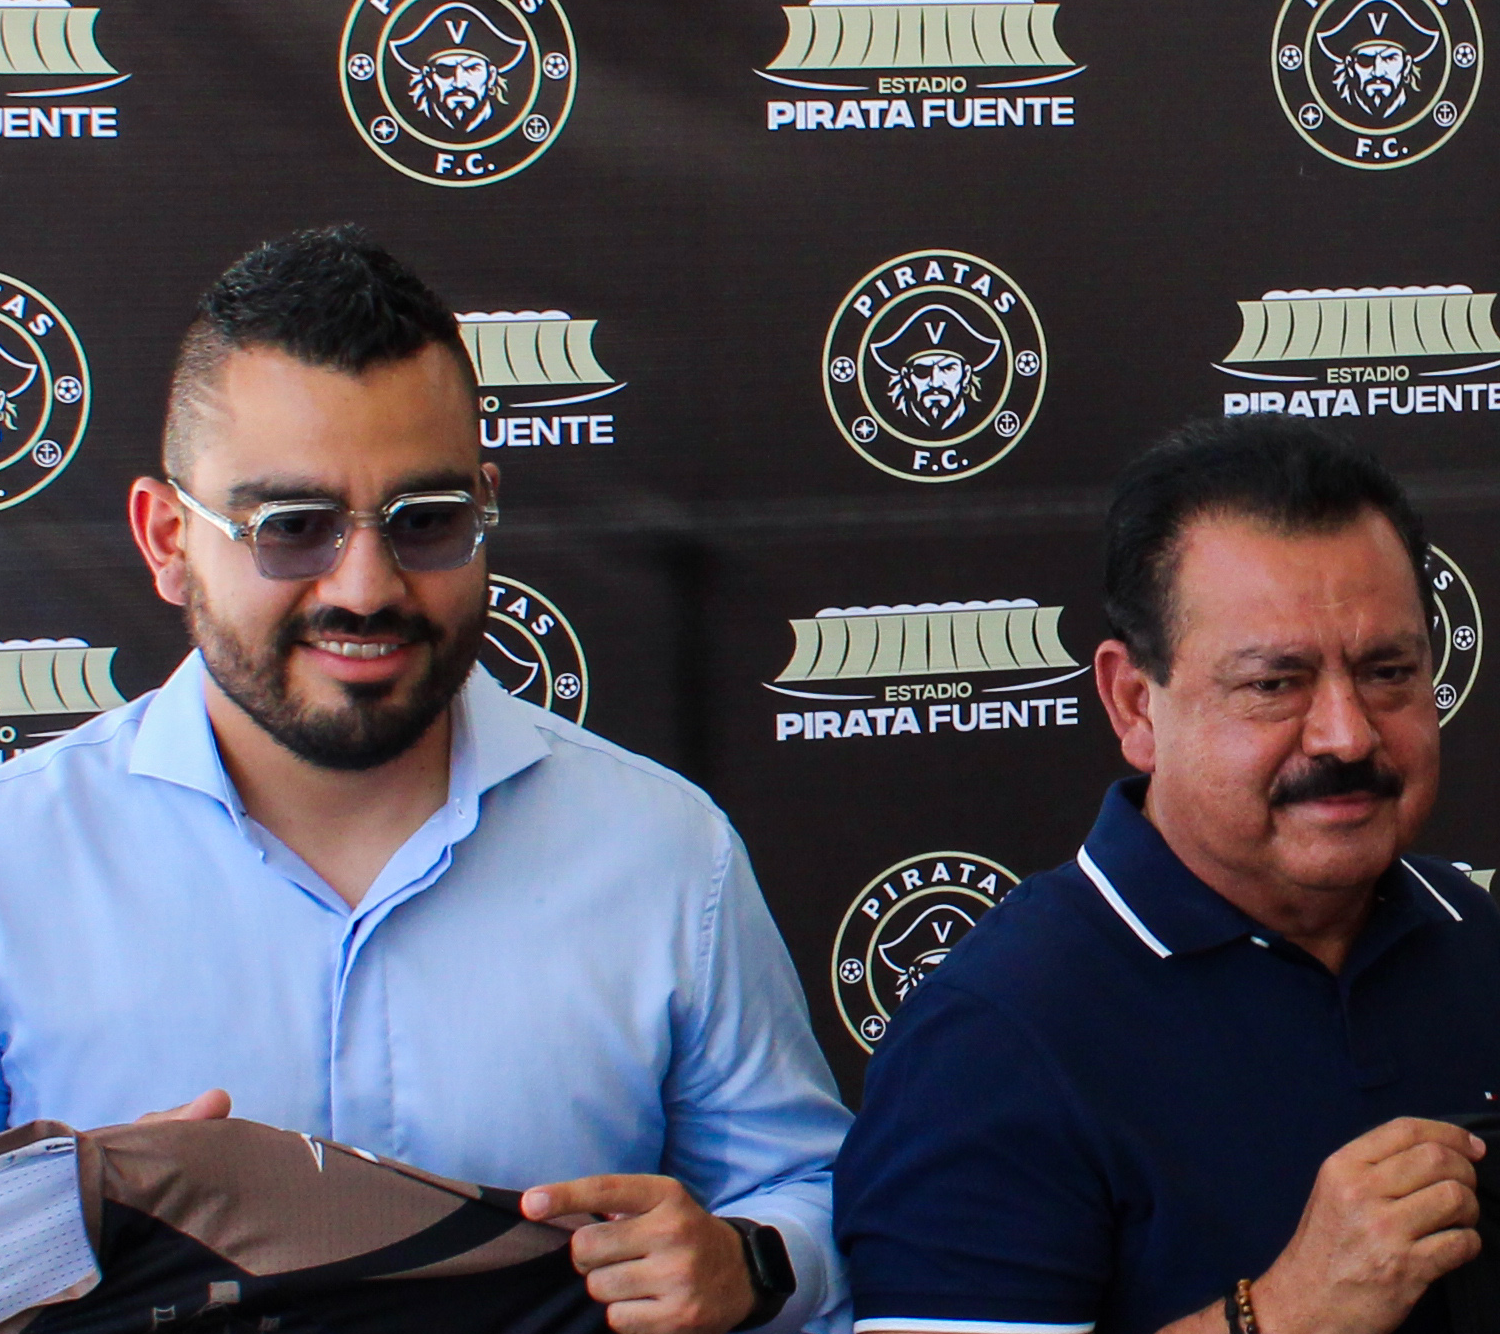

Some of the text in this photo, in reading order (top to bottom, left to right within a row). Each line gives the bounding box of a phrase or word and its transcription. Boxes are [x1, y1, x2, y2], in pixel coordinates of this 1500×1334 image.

[878, 76, 967, 94] ESTADIO
[767, 96, 1075, 130] PIRATA FUENTE
[1355, 137, 1409, 159] F.C.
[435, 152, 495, 176] F.C.
[853, 260, 1016, 318] PIRATAS
[1326, 364, 1410, 384] ESTADIO
[1223, 389, 1361, 418] PIRATA
[479, 415, 615, 448] UENTE
[912, 449, 969, 472] F.C.
[885, 681, 973, 702] ESTADIO
[776, 697, 1078, 742] PIRATA FUENTE
[861, 862, 1012, 920] PIRATA
